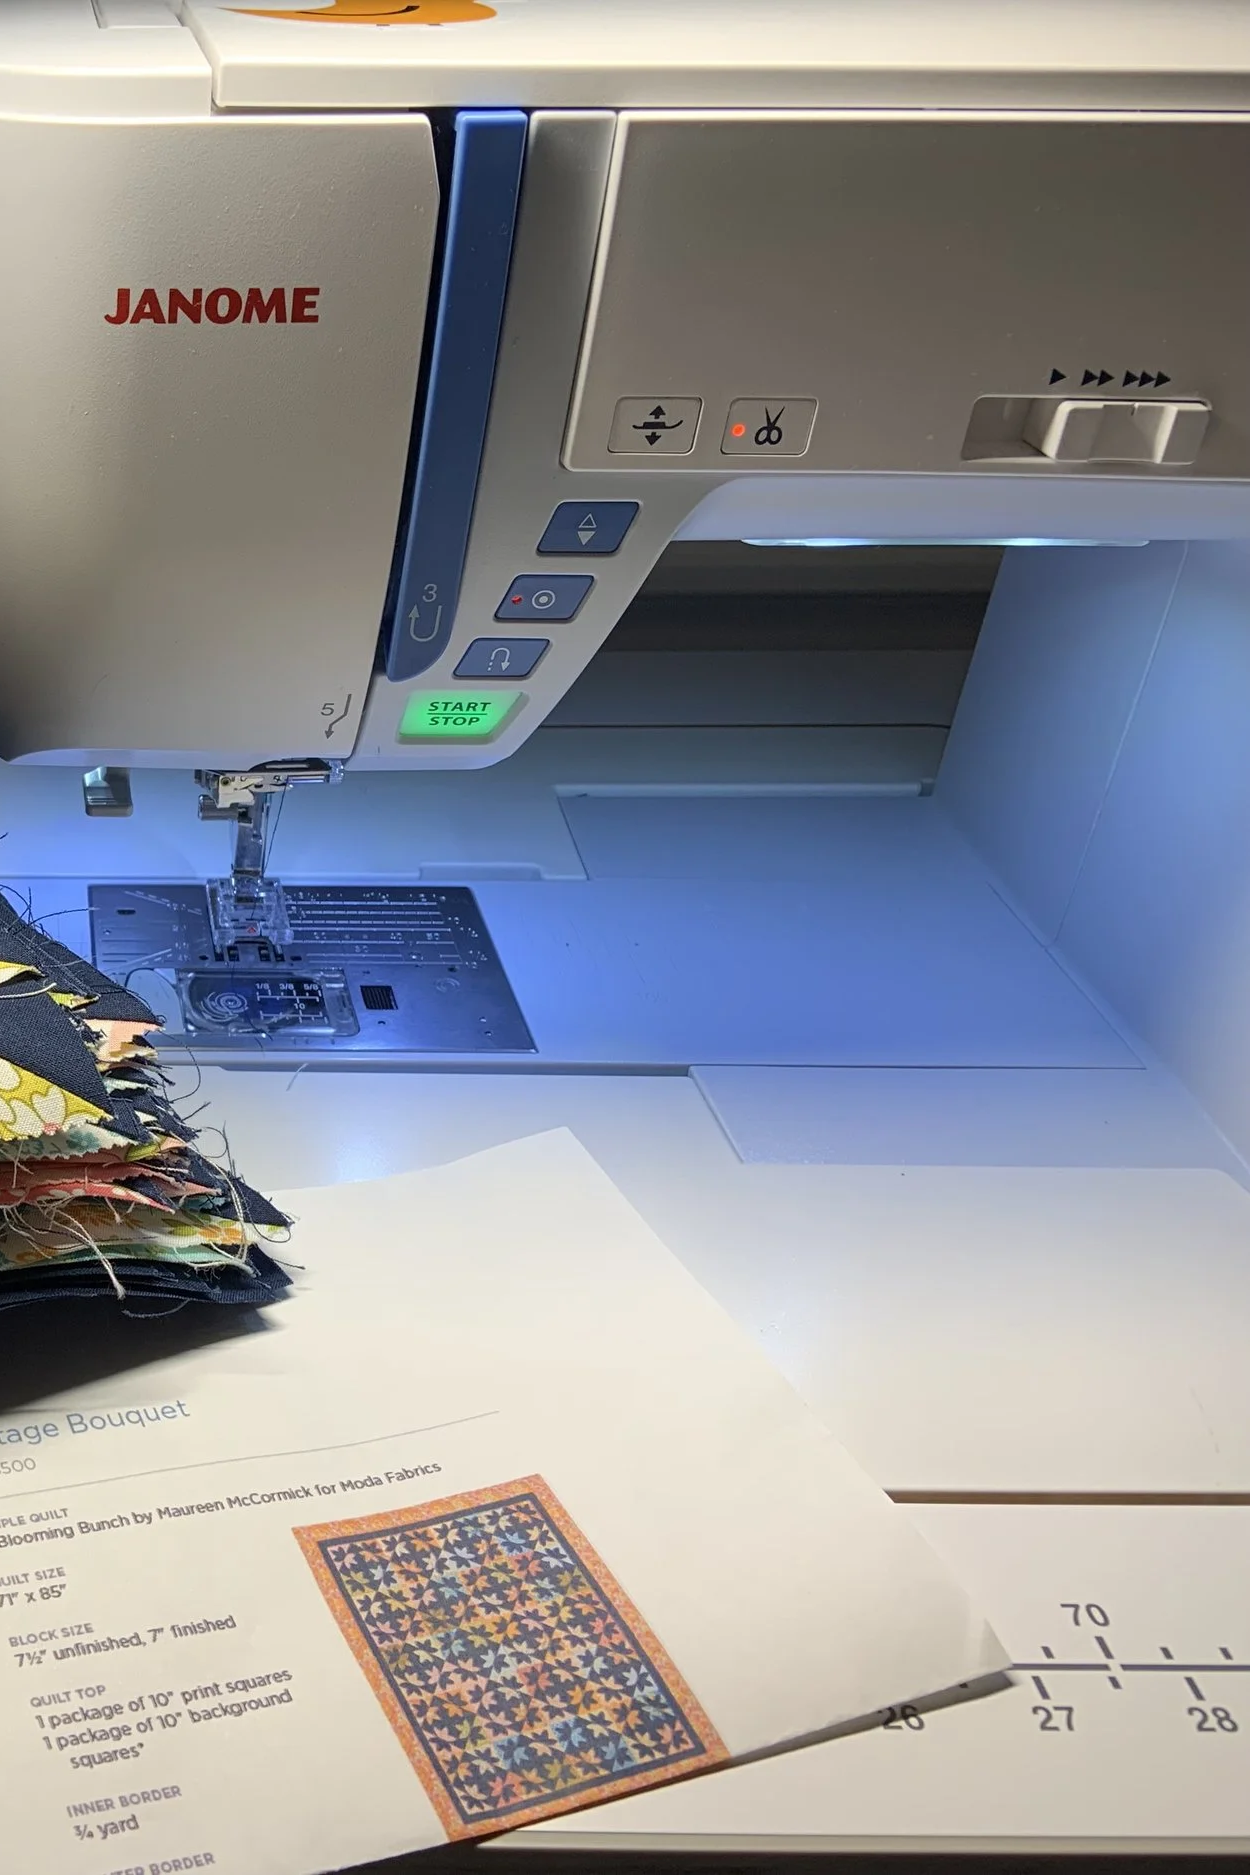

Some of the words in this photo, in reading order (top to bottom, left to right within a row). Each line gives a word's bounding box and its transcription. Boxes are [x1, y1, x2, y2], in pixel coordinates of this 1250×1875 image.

[104, 287, 321, 325] JANOME
[422, 583, 439, 603] 3
[320, 703, 335, 717] 5
[427, 700, 492, 713] START
[428, 716, 481, 727] STOP
[66, 1400, 191, 1434] Bouquet
[77, 1515, 131, 1535] Bunch
[131, 1510, 153, 1525] by
[156, 1498, 226, 1520] Maureen
[227, 1486, 313, 1510] McCormick
[314, 1483, 338, 1497] for
[339, 1475, 384, 1492] Moda
[385, 1461, 443, 1484] Fabrics
[29, 1508, 69, 1524] QUILT
[35, 1566, 66, 1581] SIZE
[24, 1591, 36, 1604] x
[1059, 1603, 1110, 1627] 70
[8, 1629, 59, 1648] BLOCK
[61, 1622, 94, 1638] SIZE
[53, 1632, 147, 1661] unfinished,
[170, 1615, 237, 1639] finished
[30, 1691, 71, 1708] QUILT
[75, 1684, 106, 1701] TOP
[35, 1714, 45, 1729] 1
[50, 1701, 124, 1730] package
[128, 1696, 146, 1711] of
[180, 1682, 223, 1705] print
[225, 1668, 293, 1694] squares
[42, 1735, 53, 1750] 1
[56, 1723, 132, 1751] package
[136, 1717, 154, 1733] of
[188, 1689, 293, 1724] background
[877, 1705, 925, 1730] 26
[1032, 1706, 1075, 1732] 27
[1188, 1706, 1239, 1733] 28
[66, 1798, 116, 1818] INNER
[118, 1785, 182, 1808] BORDER
[97, 1814, 140, 1840] yard
[148, 1852, 216, 1875] BORDER
